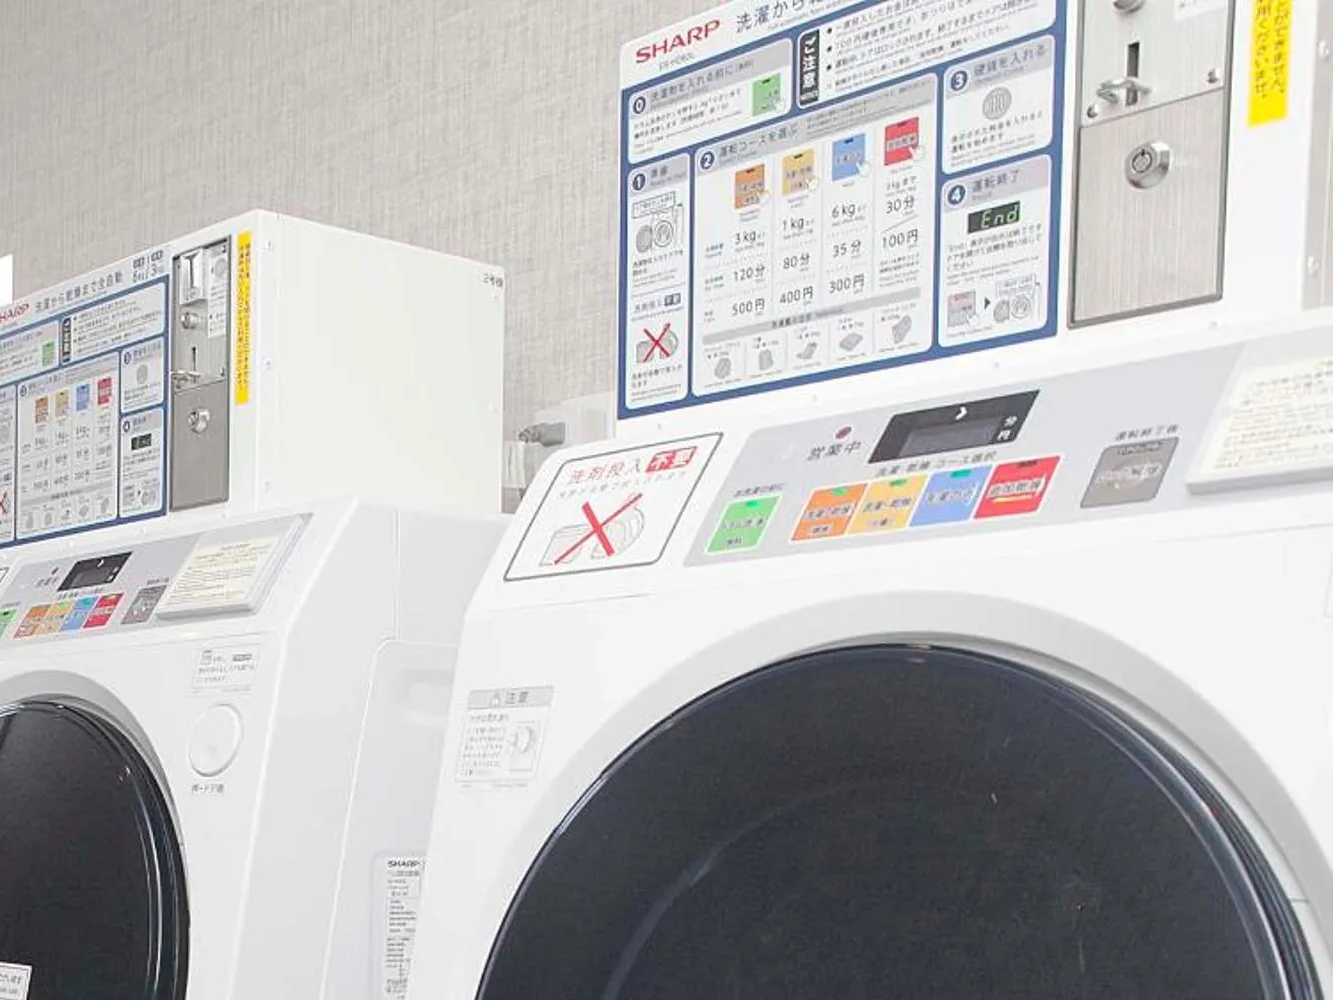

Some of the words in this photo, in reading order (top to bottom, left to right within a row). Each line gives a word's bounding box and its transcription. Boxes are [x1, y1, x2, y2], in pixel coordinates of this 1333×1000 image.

[635, 18, 721, 65] SHARP
[885, 195, 916, 214] 30分
[980, 205, 1018, 229] End
[882, 229, 919, 249] 100円
[833, 240, 862, 258] 35分
[782, 252, 811, 271] 80分
[733, 264, 766, 283] 120分
[829, 274, 865, 294] 300円
[779, 286, 814, 305] 400円
[731, 298, 766, 317] 500円
